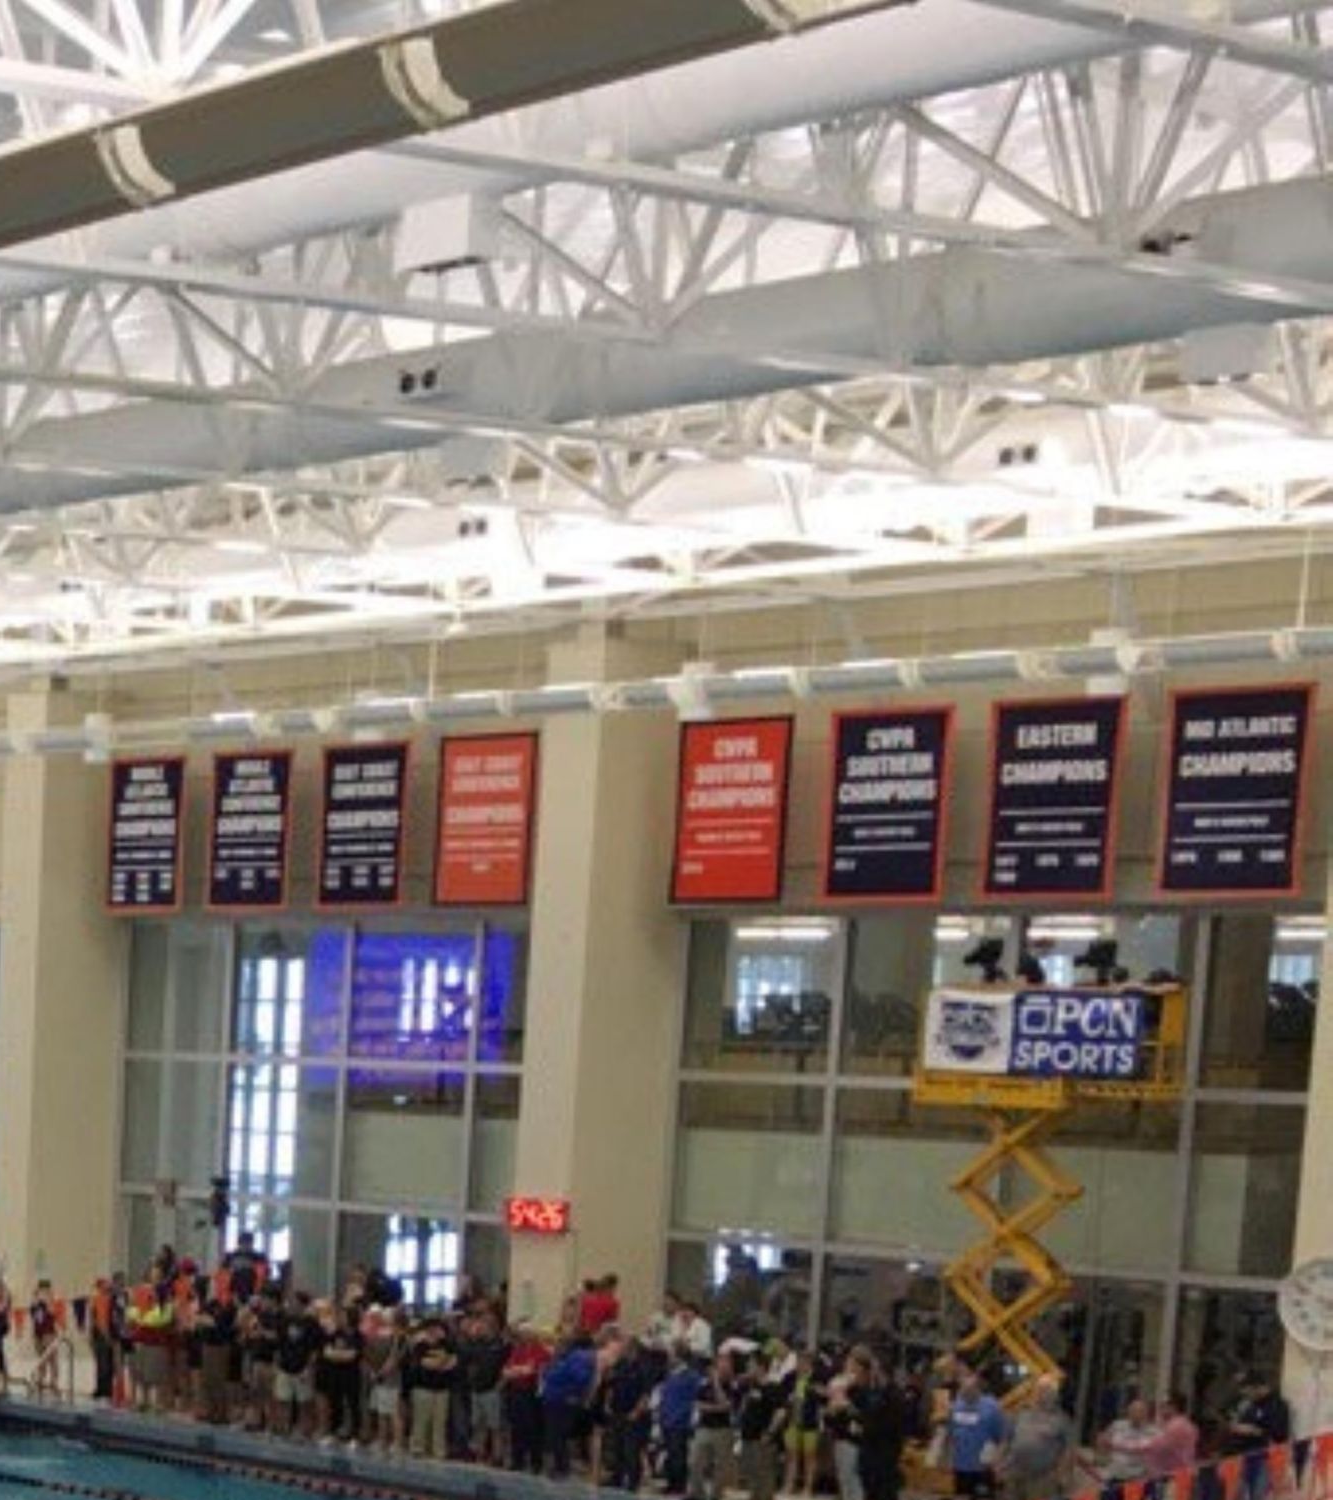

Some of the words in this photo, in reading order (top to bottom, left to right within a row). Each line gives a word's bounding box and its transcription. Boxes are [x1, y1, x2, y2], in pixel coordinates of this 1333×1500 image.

[1017, 722, 1098, 749] EASTERN
[1217, 717, 1297, 737] ATLANTIC
[1001, 759, 1108, 786] CHAMPIONS
[1179, 751, 1296, 778] CHAMPIONS
[838, 779, 937, 804] CHAMPIONS
[1014, 1041, 1134, 1074] SPORTS
